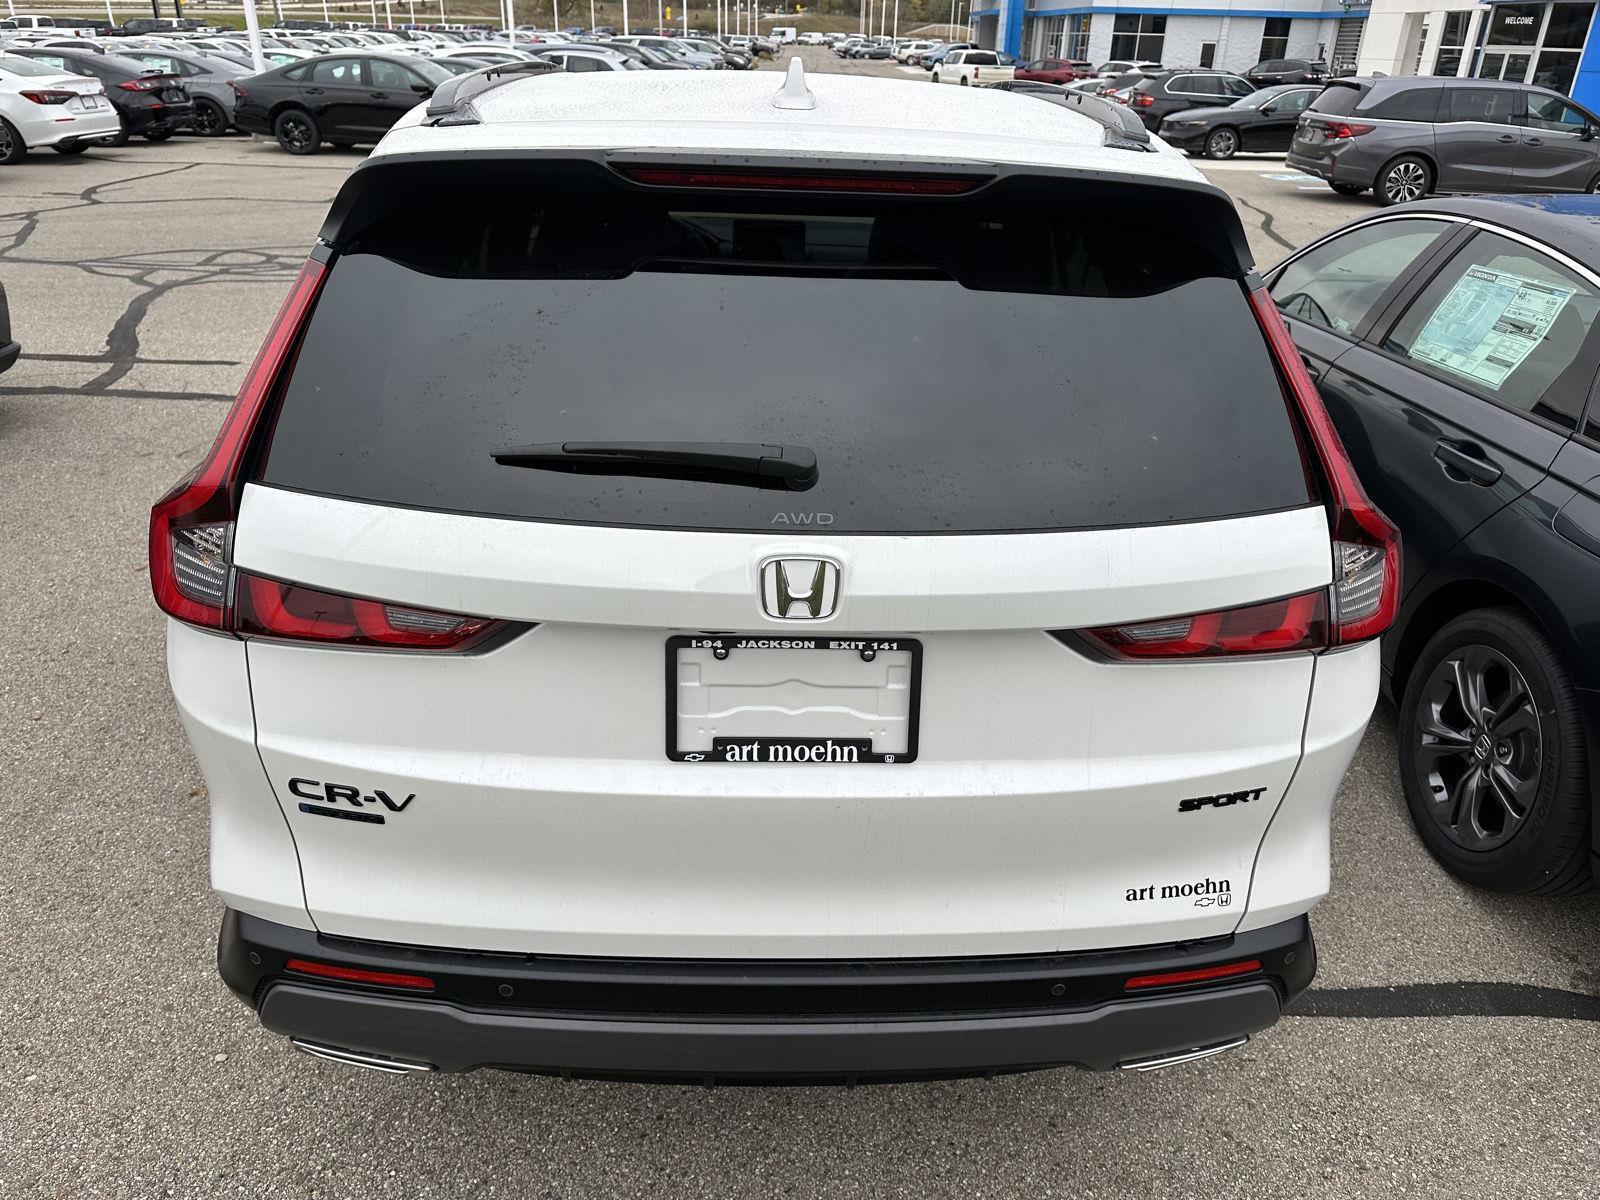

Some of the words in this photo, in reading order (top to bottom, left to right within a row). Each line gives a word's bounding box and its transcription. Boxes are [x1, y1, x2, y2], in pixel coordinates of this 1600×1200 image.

[1505, 16, 1534, 25] WELCOME
[1474, 271, 1496, 282] HONDA
[771, 512, 834, 525] AWD
[691, 639, 723, 649] I-94
[737, 640, 815, 650] JACKSON
[829, 641, 866, 650] EXIT
[871, 642, 898, 651] 141
[725, 742, 760, 762] art
[768, 740, 859, 763] moehn
[288, 777, 416, 812] CR-V
[1178, 787, 1267, 812] SPORT
[1125, 884, 1155, 901] art
[1161, 878, 1231, 899] moehn
